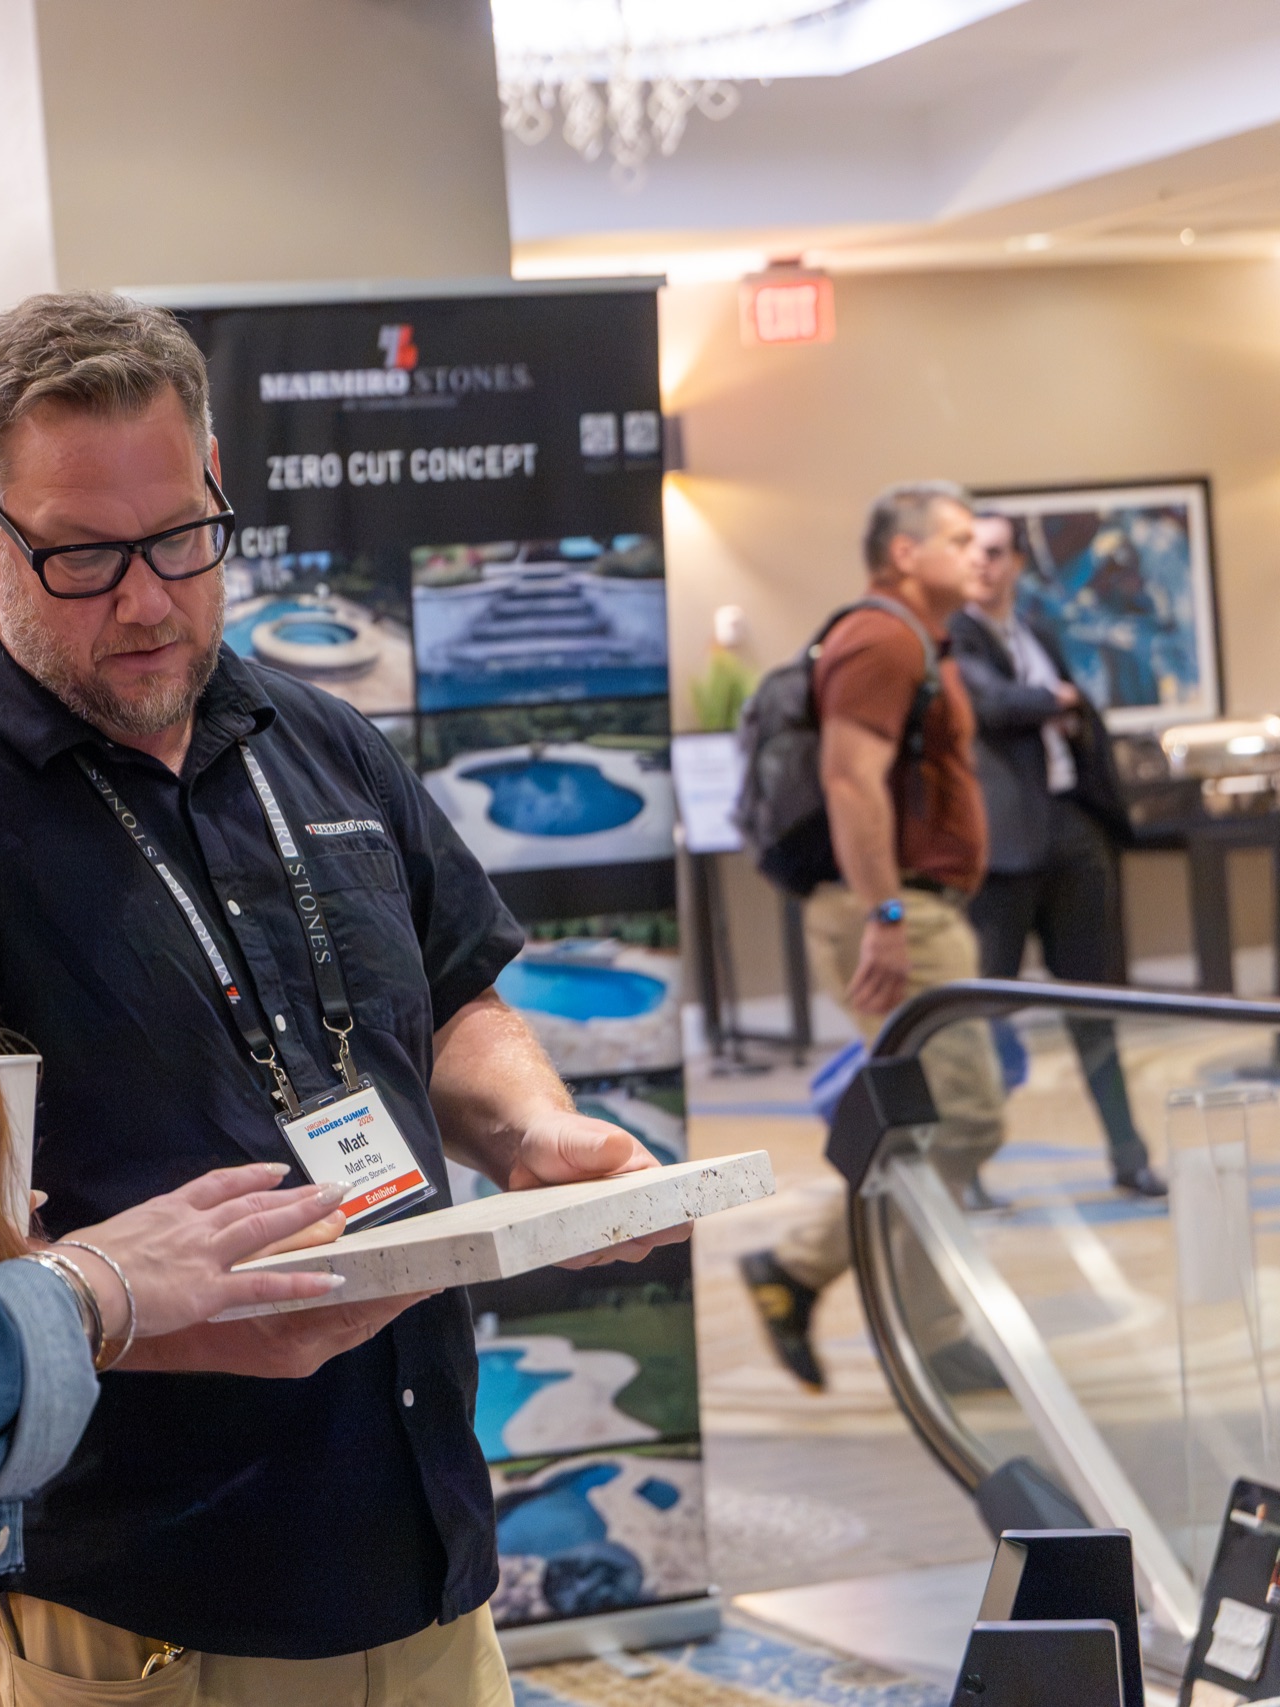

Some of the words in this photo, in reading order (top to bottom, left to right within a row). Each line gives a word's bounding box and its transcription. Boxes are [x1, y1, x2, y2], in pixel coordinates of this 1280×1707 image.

[267, 452, 343, 490] ZERO
[348, 450, 405, 485] CUT
[410, 443, 538, 482] CONCEPT
[241, 525, 291, 558] CUT
[87, 768, 158, 858] STONES
[156, 863, 232, 986] MARMIRO
[289, 863, 331, 963] STONES
[304, 1117, 331, 1132] VIRGINIA
[307, 1118, 343, 1139] BUILDERS
[343, 1106, 370, 1123] SUMMIT
[337, 1132, 369, 1155] Matt
[344, 1158, 367, 1176] Matt
[365, 1152, 383, 1165] Ray
[368, 1166, 389, 1180] Stones
[385, 1162, 397, 1171] Inc
[365, 1184, 398, 1205] Exhibitor
